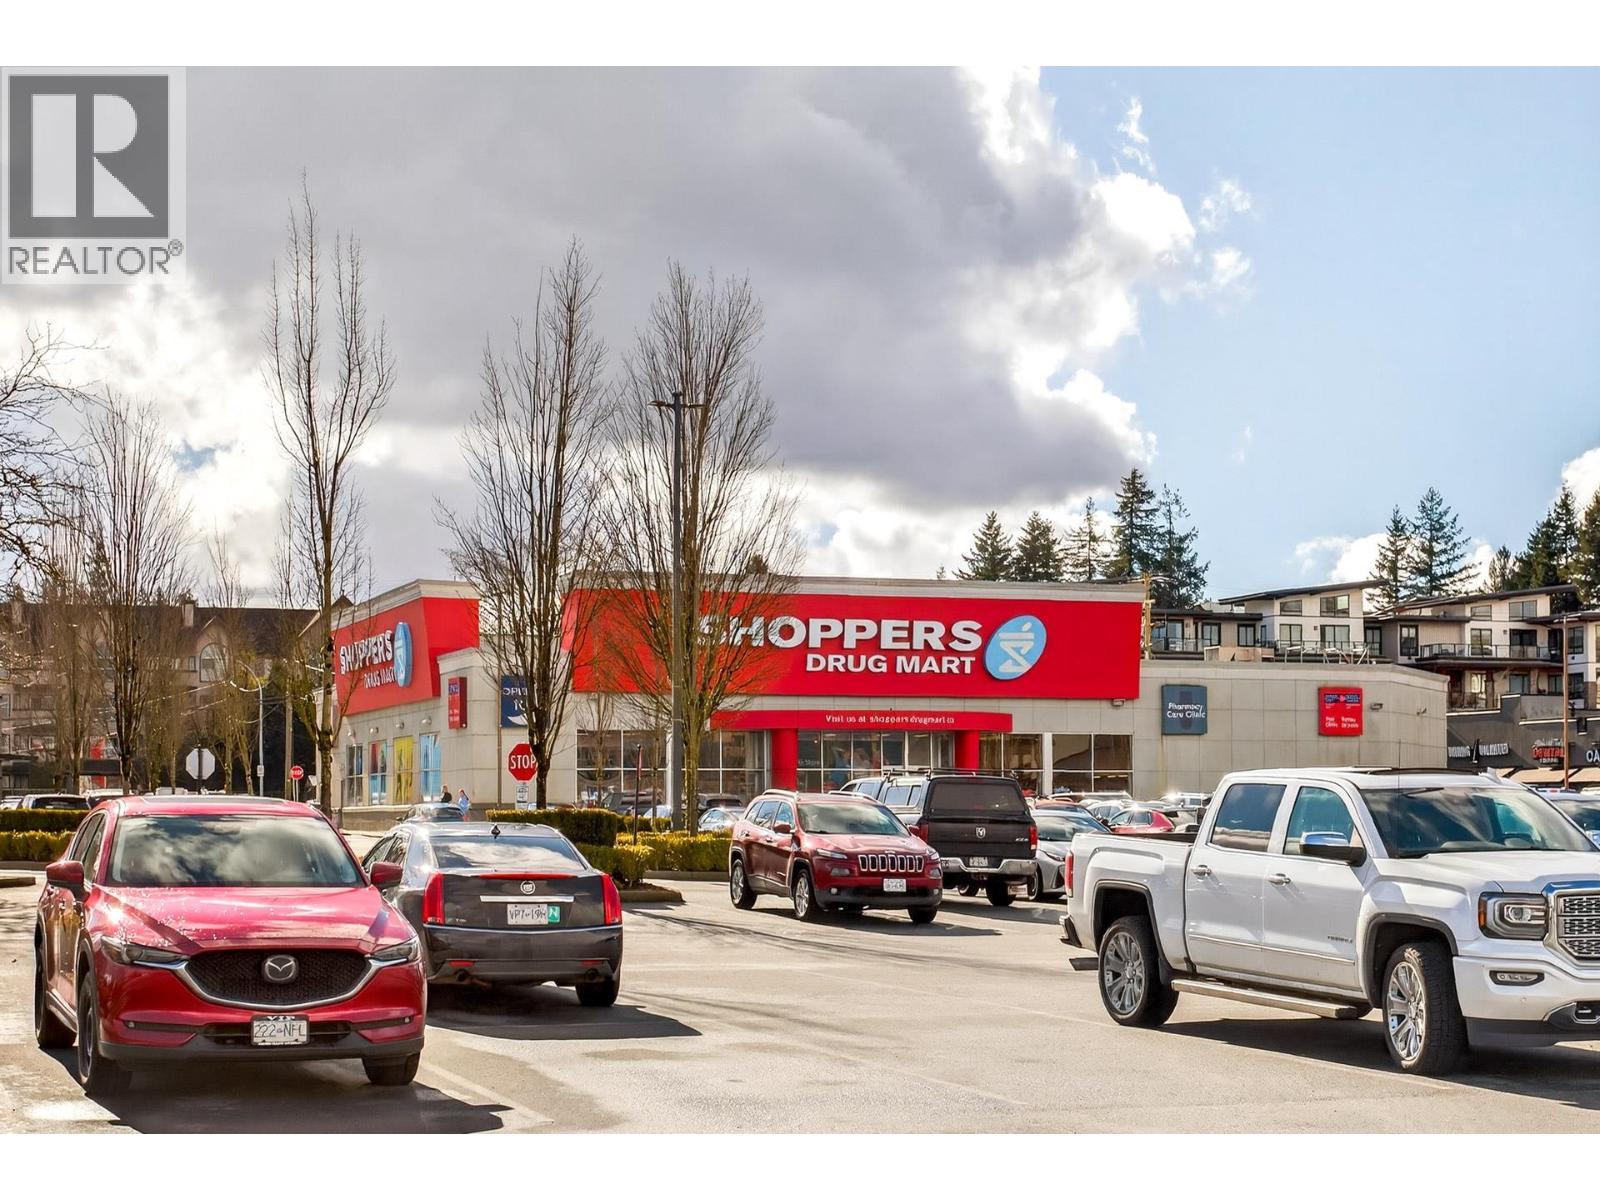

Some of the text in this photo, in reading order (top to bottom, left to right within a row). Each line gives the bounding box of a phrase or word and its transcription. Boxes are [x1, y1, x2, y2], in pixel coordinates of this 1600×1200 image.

[697, 614, 983, 652] SHOPPERS
[806, 653, 976, 674] DRUG MART
[510, 754, 537, 769] STOP
